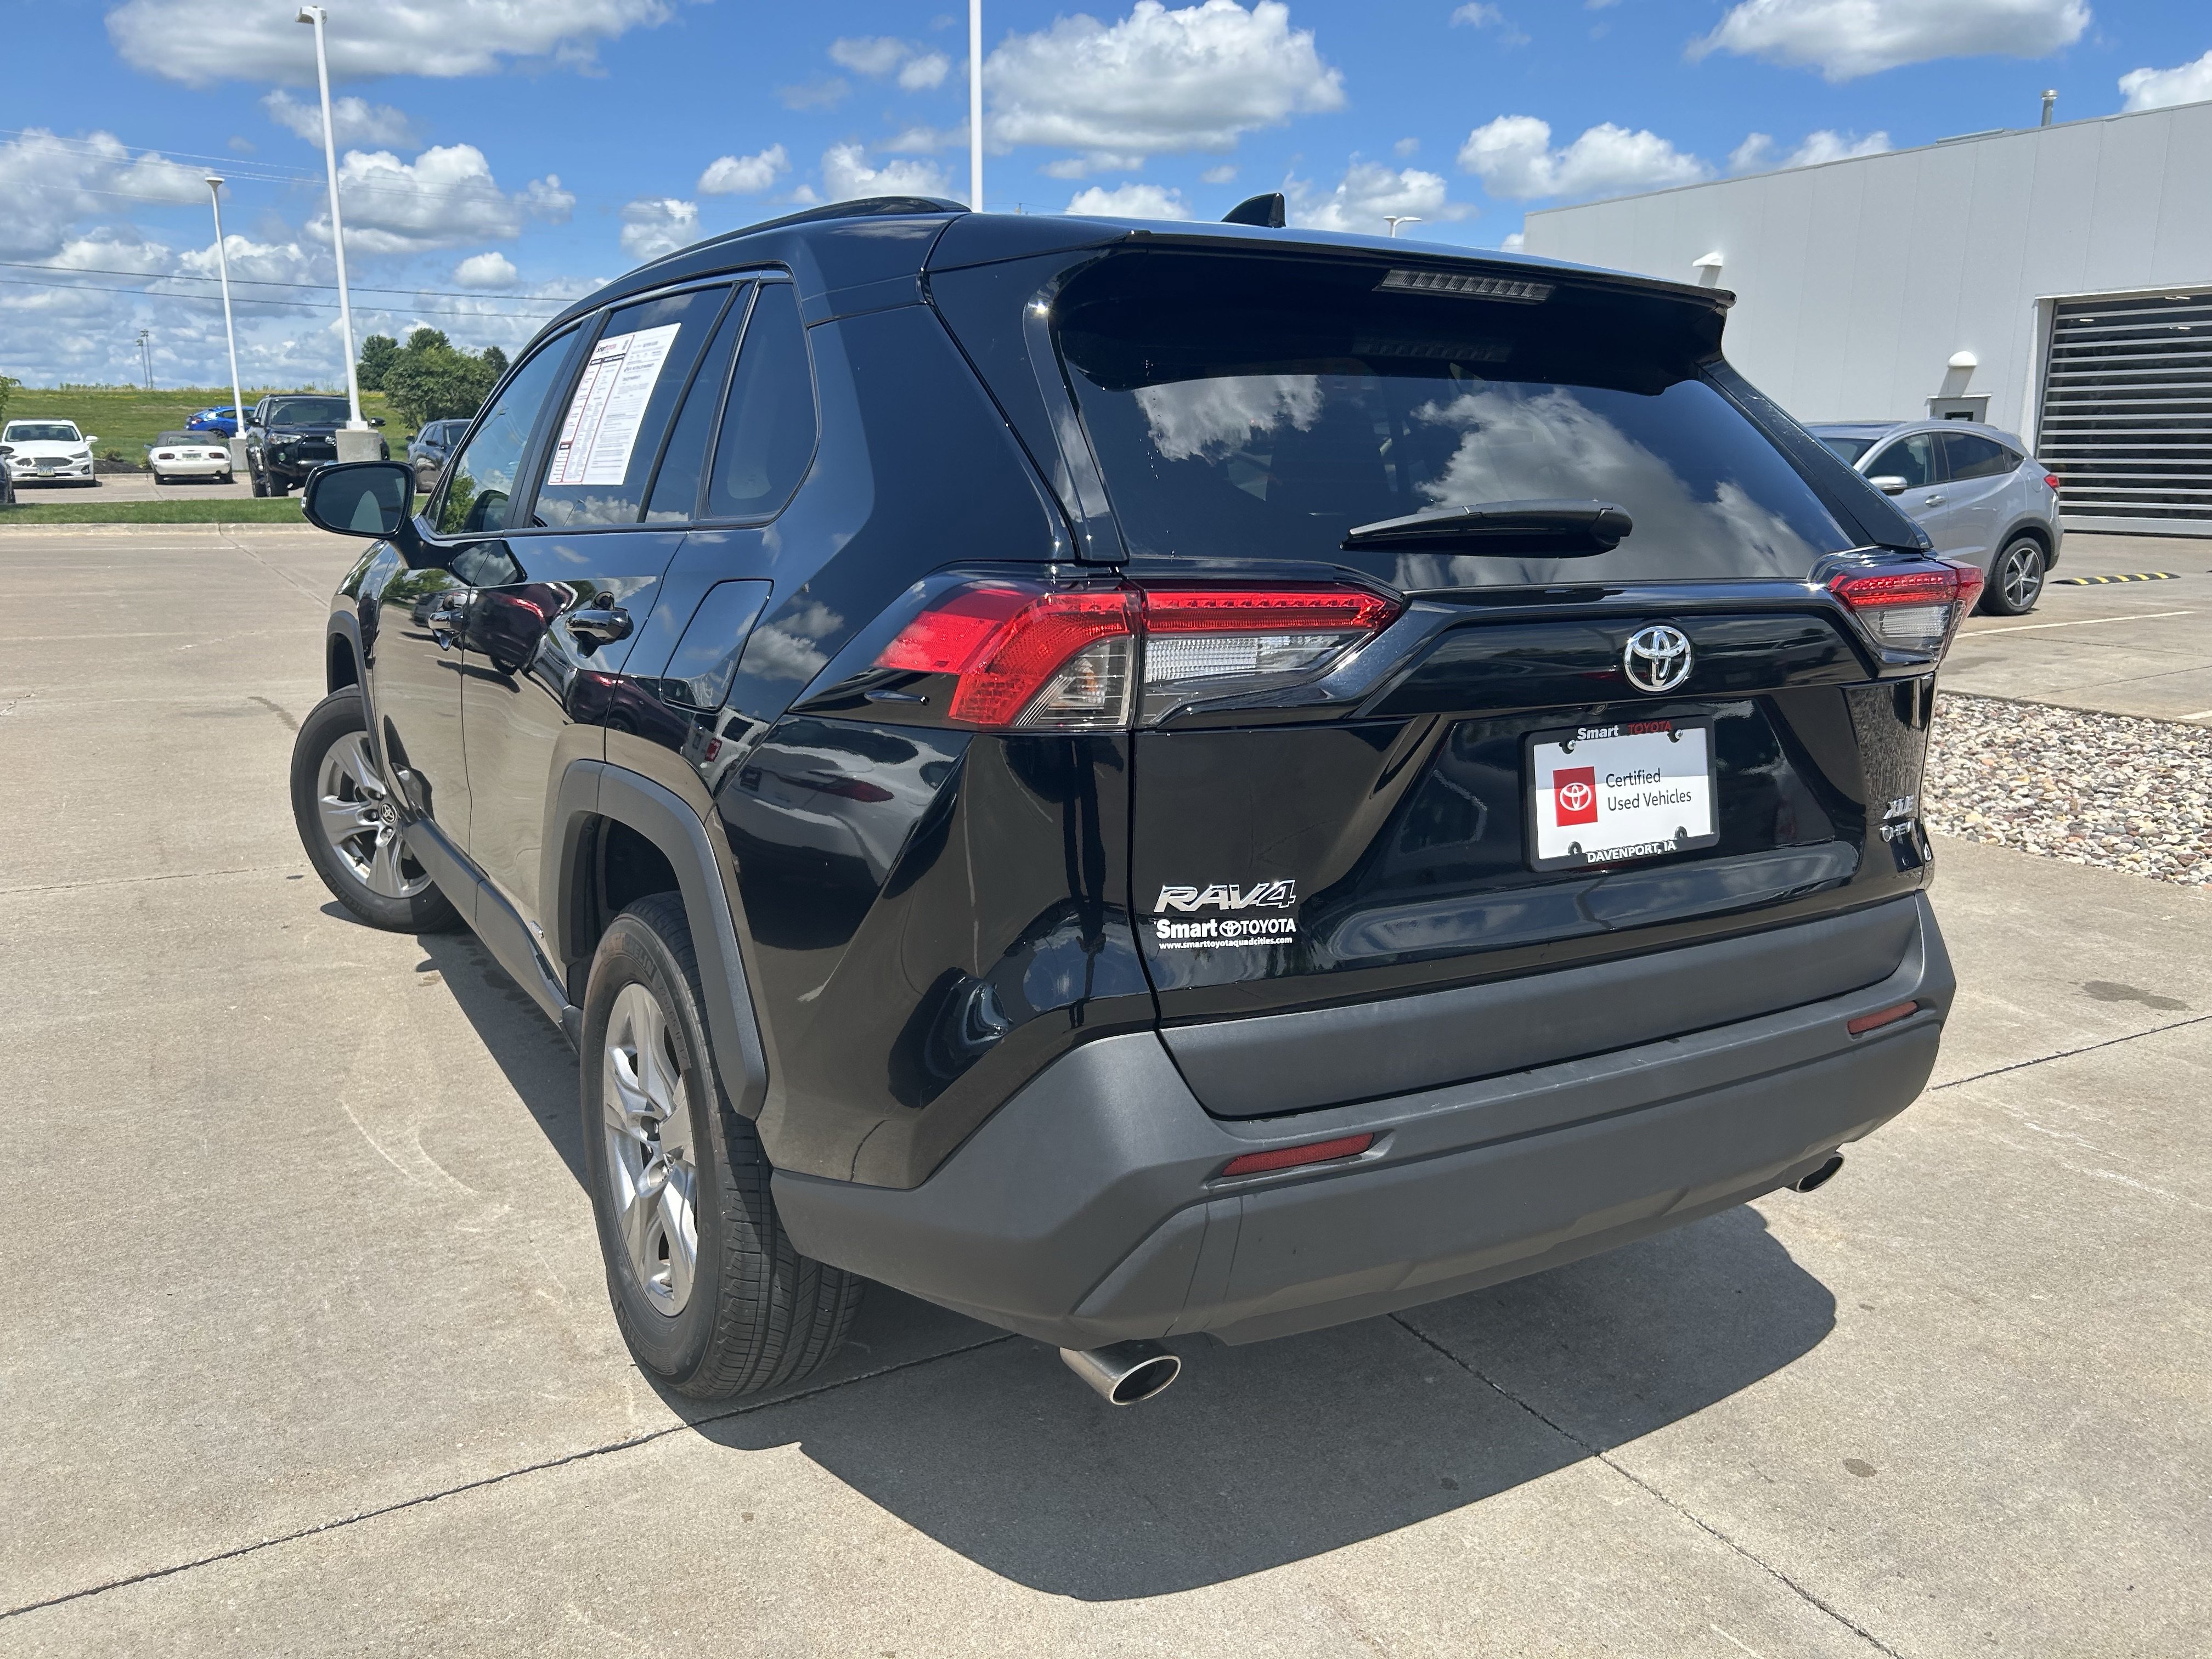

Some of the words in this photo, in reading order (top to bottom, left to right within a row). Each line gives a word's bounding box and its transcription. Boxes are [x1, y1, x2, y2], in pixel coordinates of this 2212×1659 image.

[1577, 725, 1619, 740] Smart
[1628, 720, 1672, 735] TOYOTA
[1605, 768, 1661, 788] Certified
[1607, 793, 1640, 811] Used
[1643, 789, 1692, 808] Vehicles
[1587, 842, 1661, 864] DAVENPORT,
[1663, 840, 1677, 851] IA
[1153, 879, 1296, 912] RAV4
[1156, 919, 1218, 939] Smart
[1240, 918, 1296, 935] TOYOTA
[1159, 936, 1293, 950] www.smarttoyotaquadcities.com
[601, 933, 658, 983] HELIN
